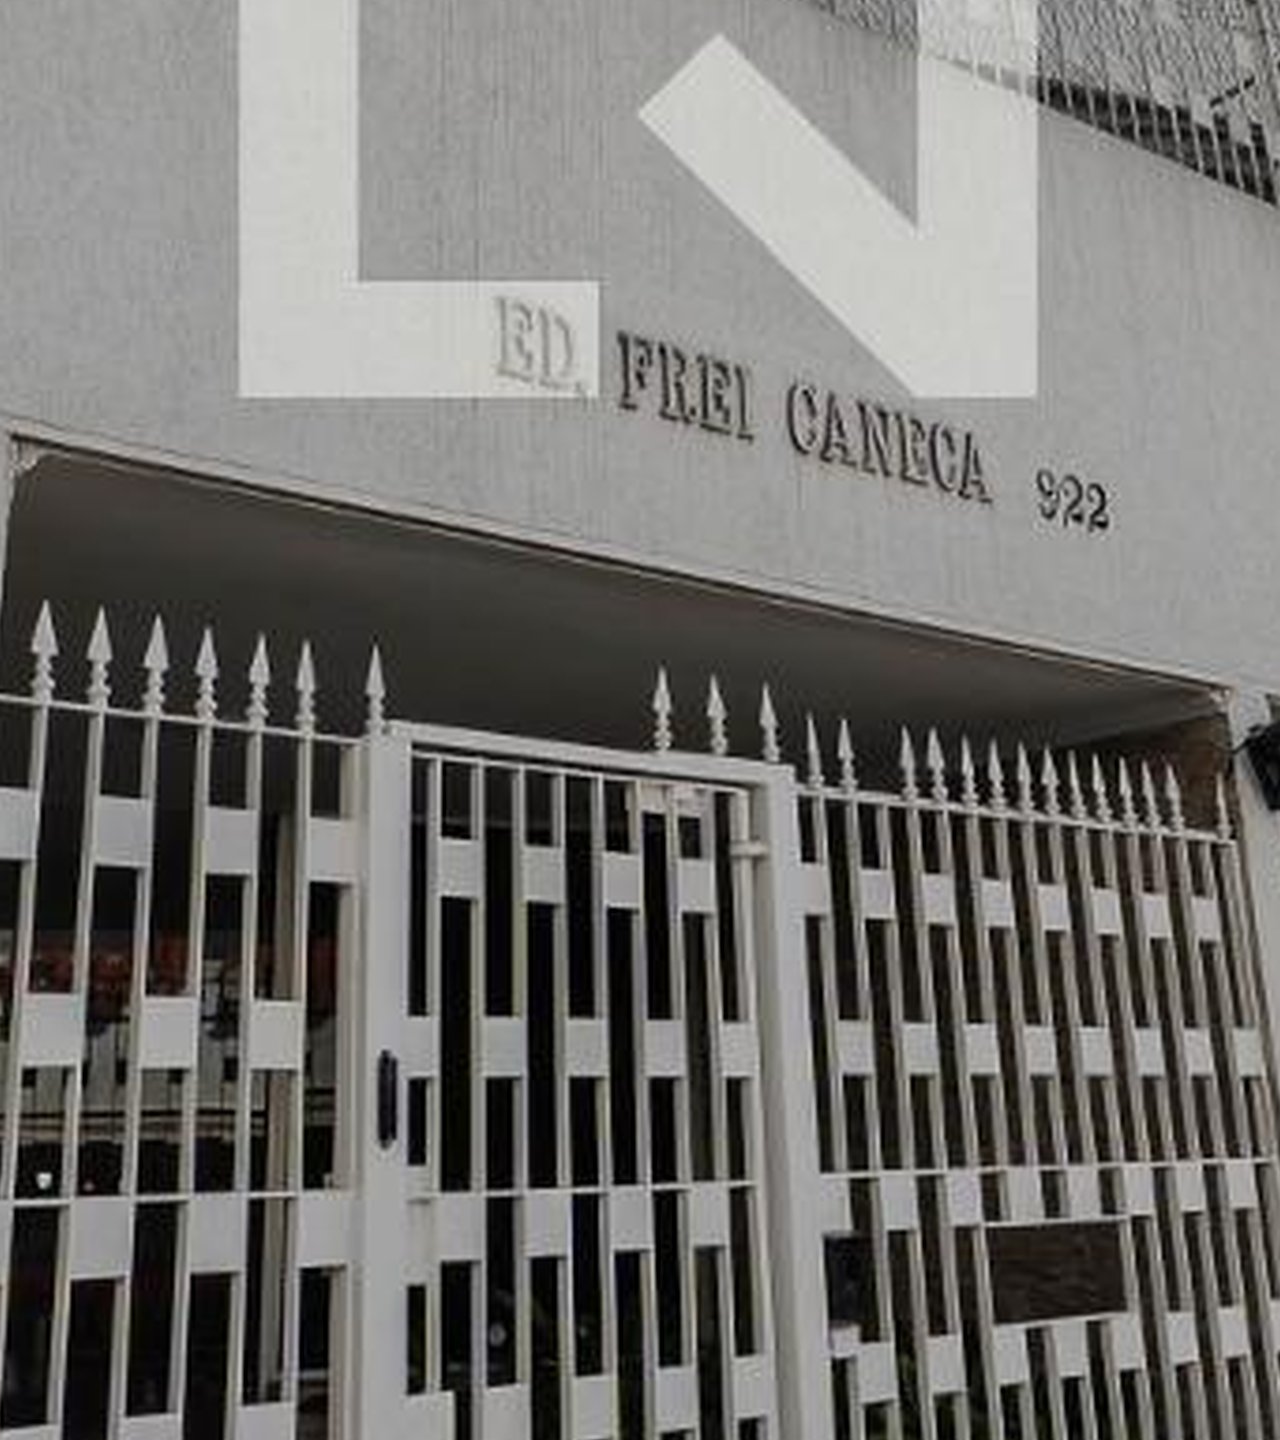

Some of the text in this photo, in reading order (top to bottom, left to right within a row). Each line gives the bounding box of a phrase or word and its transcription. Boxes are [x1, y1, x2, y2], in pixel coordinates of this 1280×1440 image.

[617, 331, 755, 442] FREI
[786, 380, 995, 504] CANECA
[1036, 469, 1109, 533] 922
